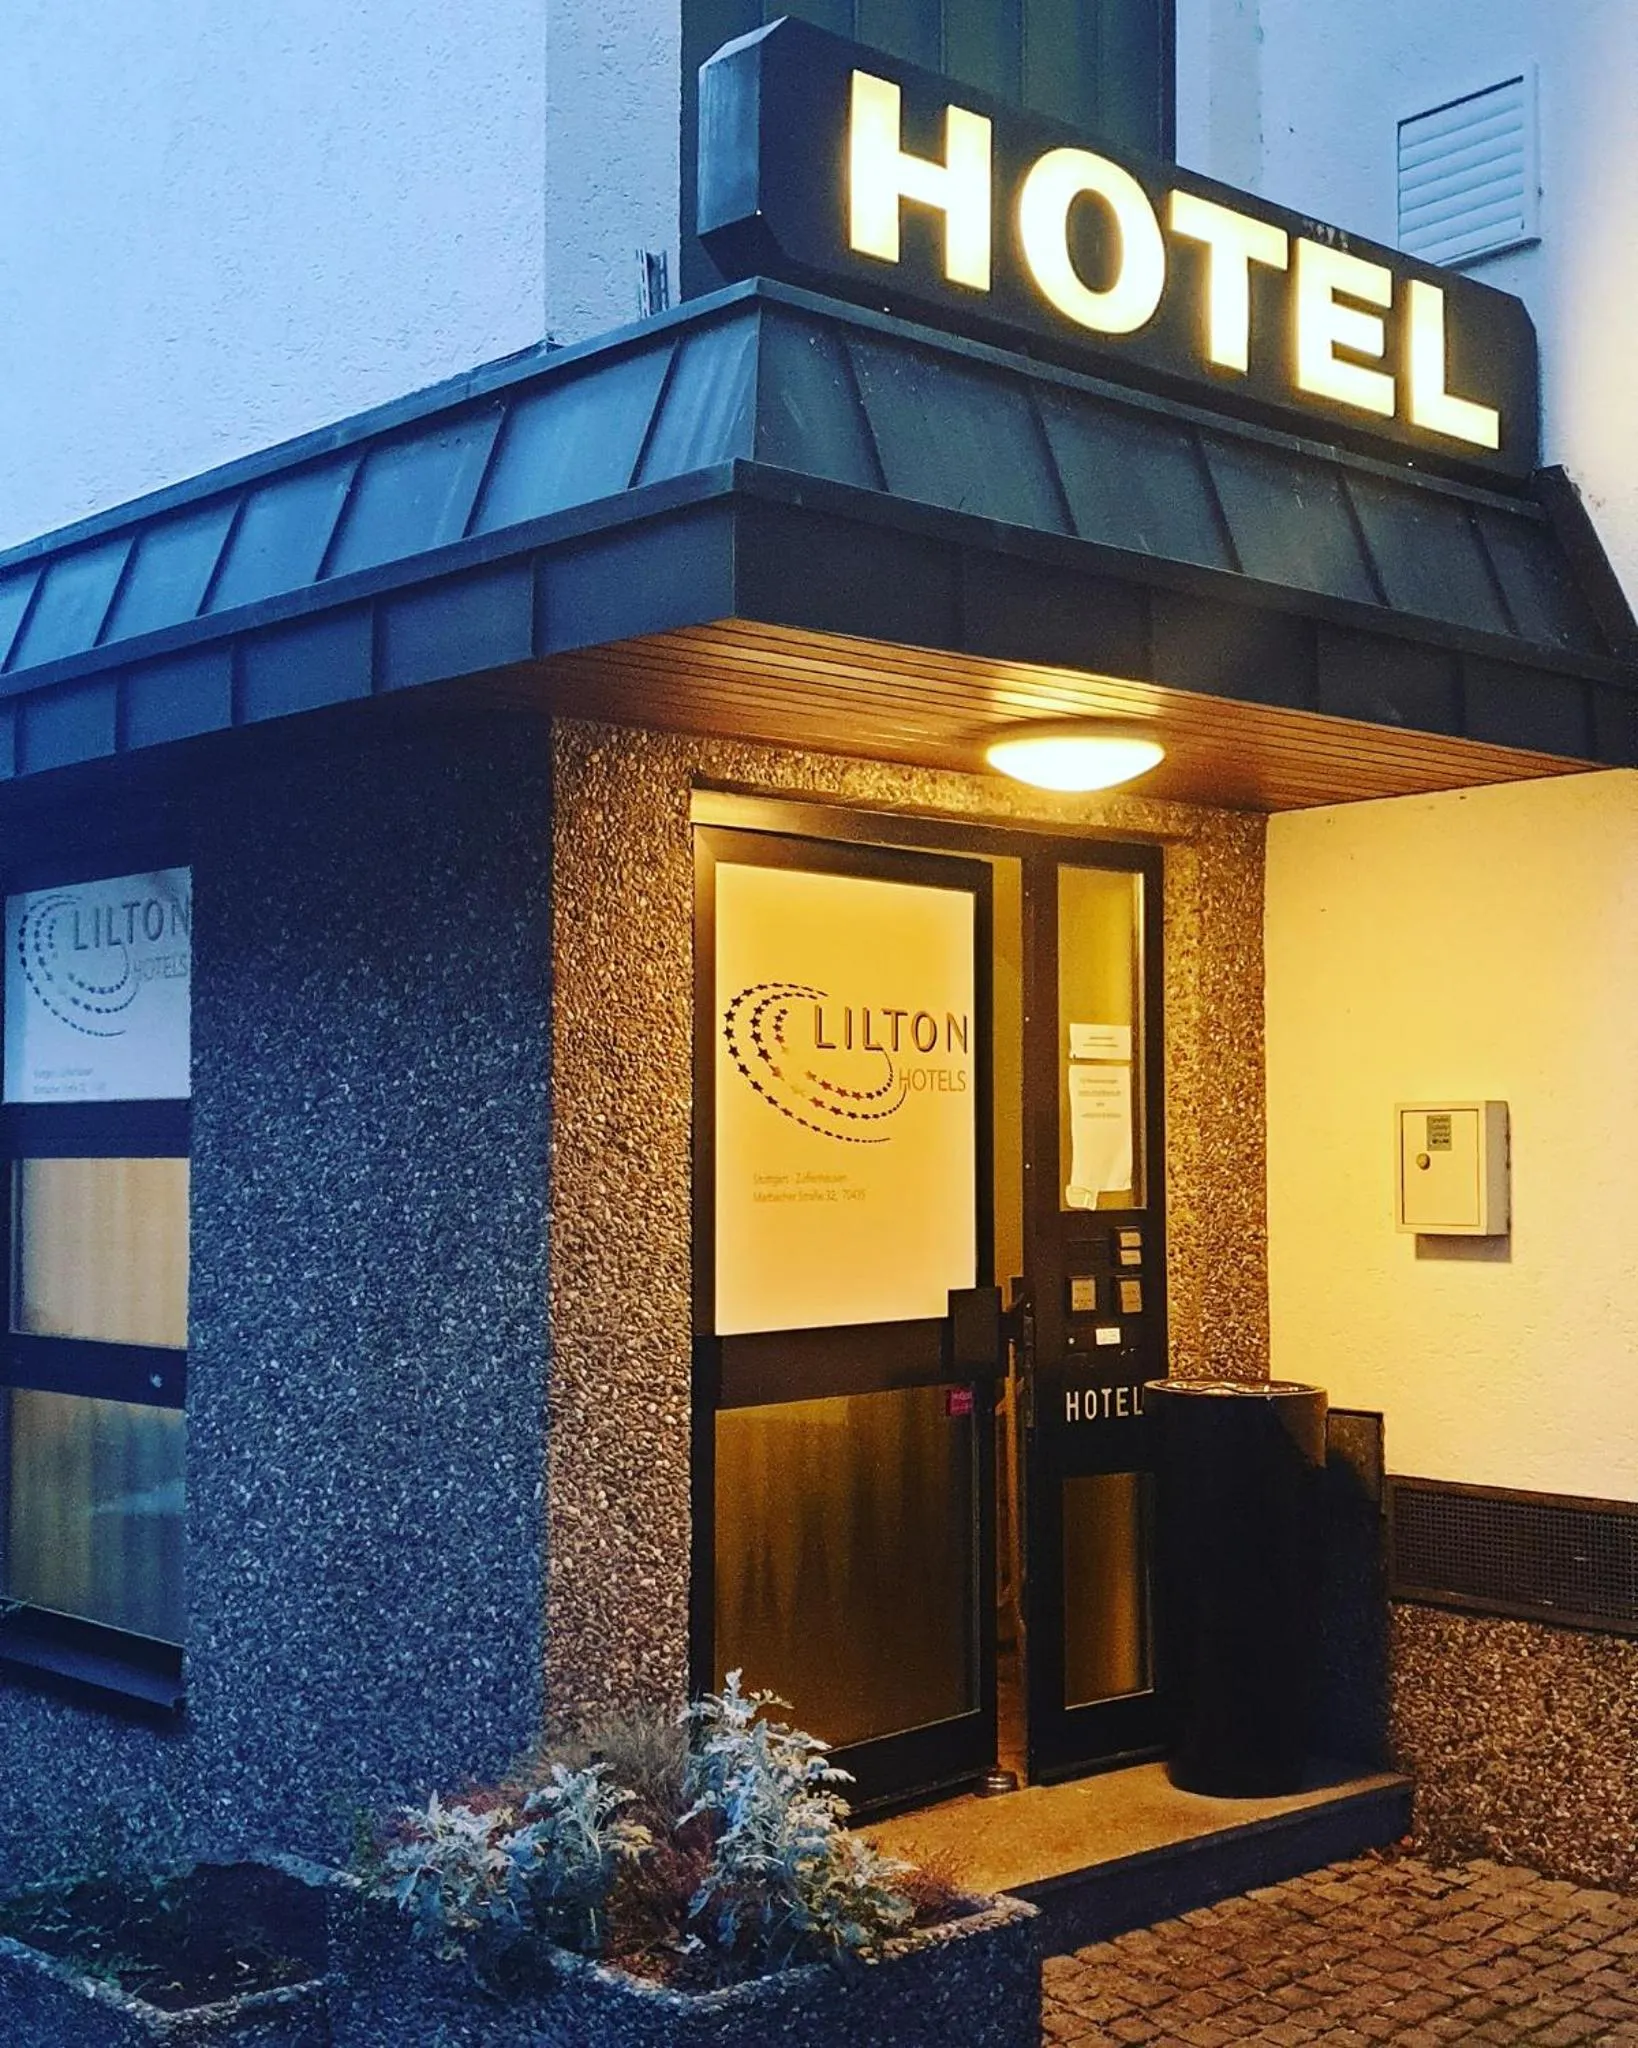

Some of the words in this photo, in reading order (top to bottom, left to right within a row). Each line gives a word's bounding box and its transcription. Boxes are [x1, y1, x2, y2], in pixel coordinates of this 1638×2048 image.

[850, 69, 1499, 450] HOTEL
[73, 897, 189, 951] LILTON
[133, 954, 188, 982] HOTELS
[813, 1004, 968, 1054] LILTON
[899, 1067, 967, 1093] HOTELS
[1066, 1386, 1144, 1422] HOTEL
